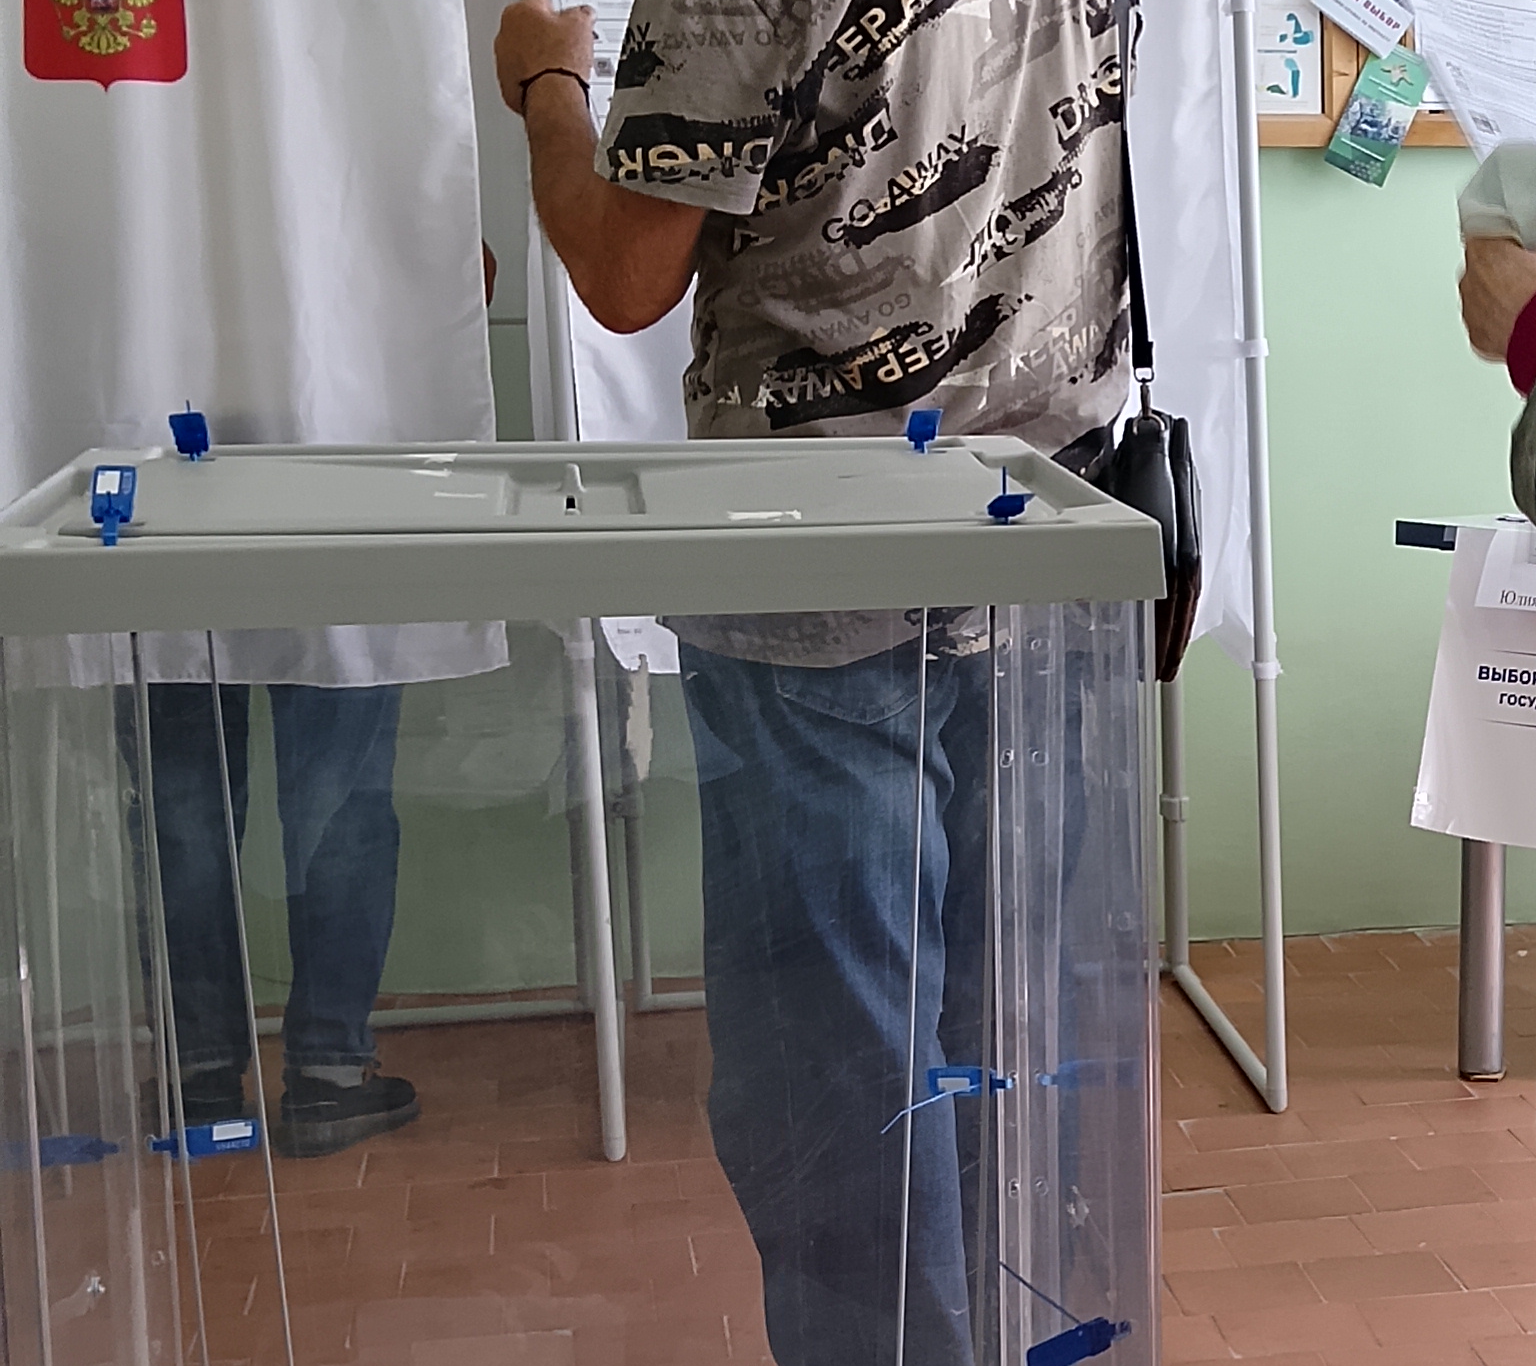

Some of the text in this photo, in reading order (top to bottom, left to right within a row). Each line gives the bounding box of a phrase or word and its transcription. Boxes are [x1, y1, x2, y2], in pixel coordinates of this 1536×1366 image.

[617, 136, 775, 183] DNGR
[822, 124, 979, 244] GO AWAY
